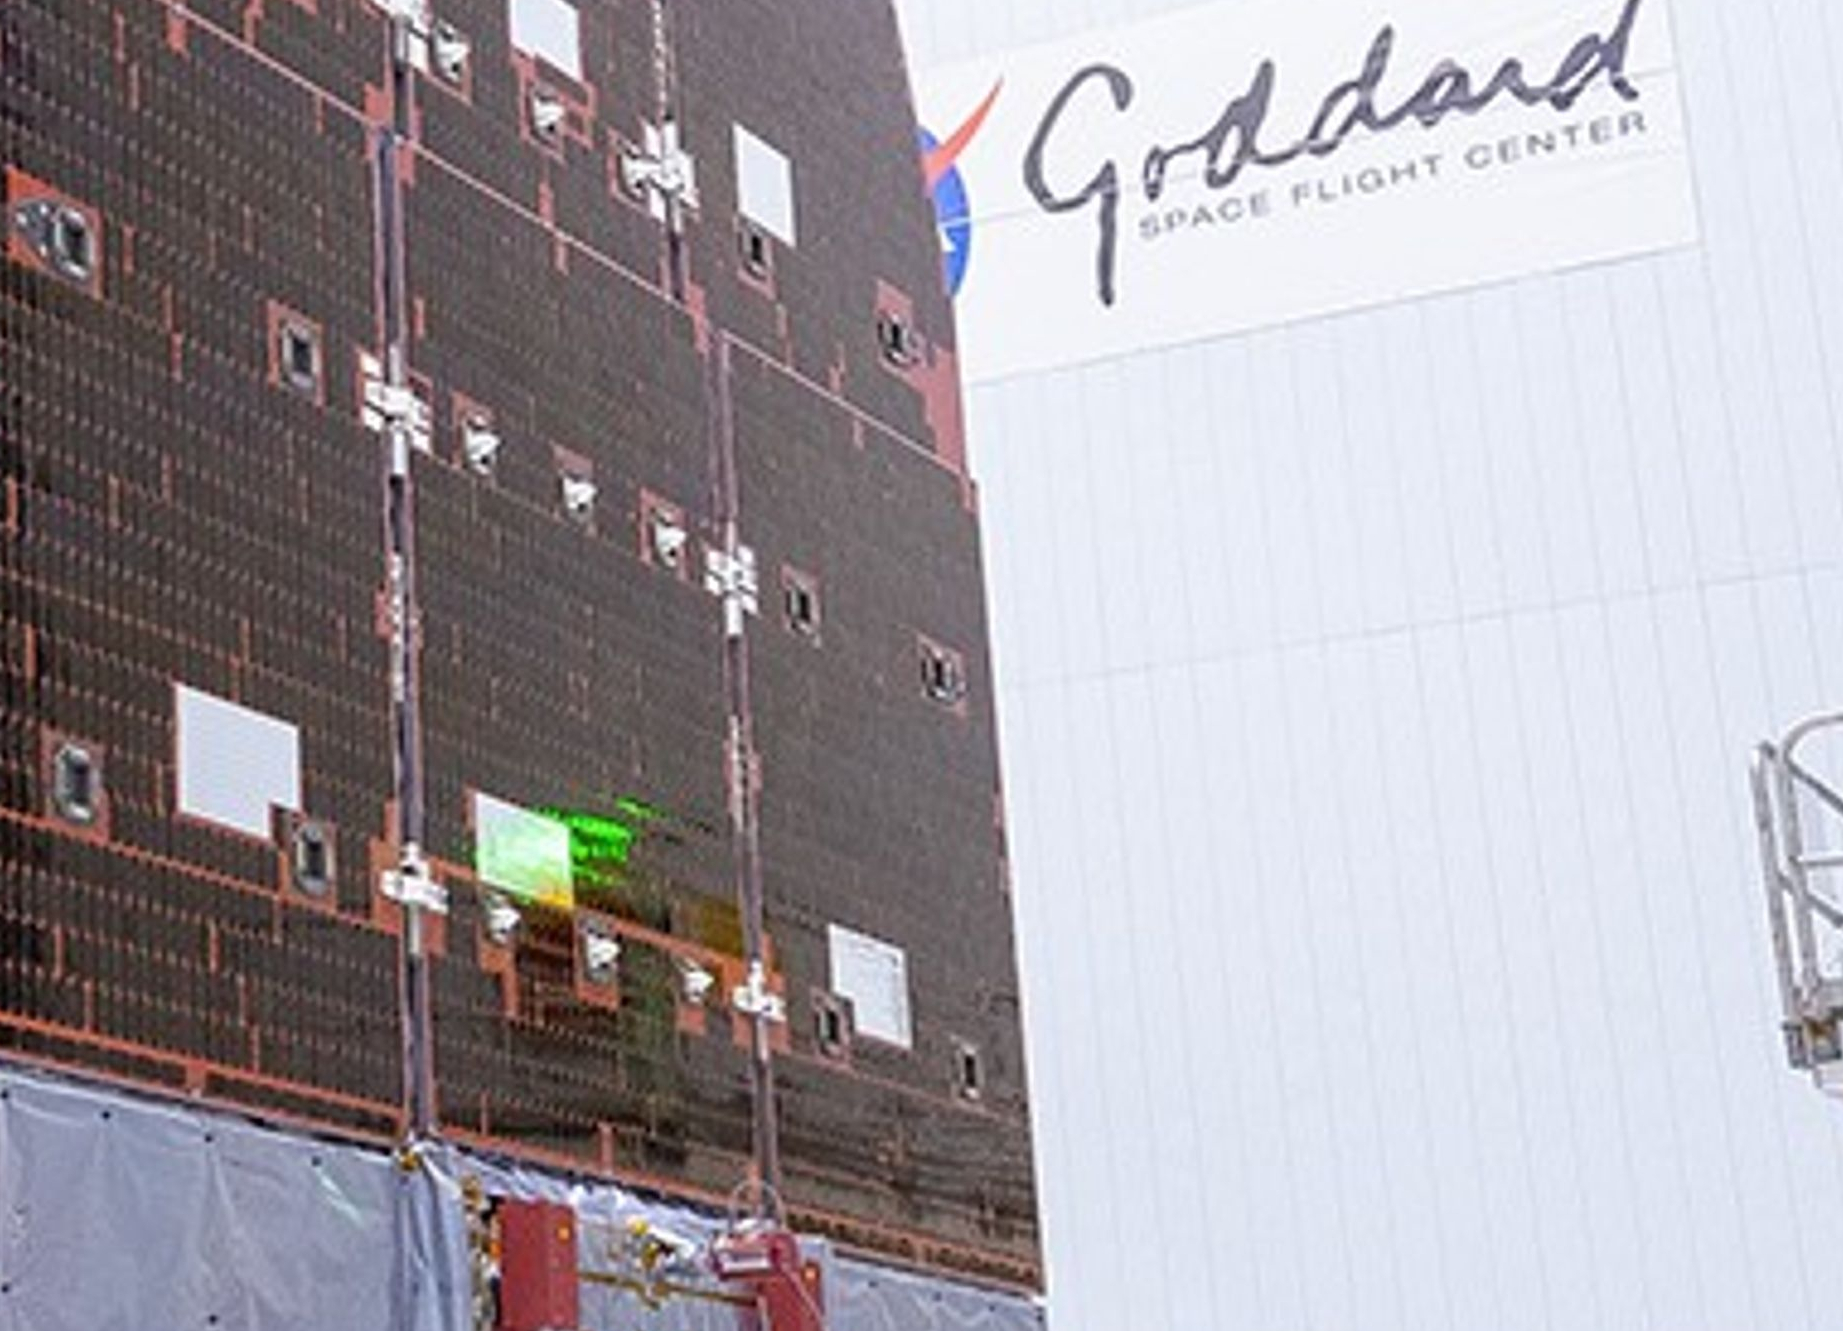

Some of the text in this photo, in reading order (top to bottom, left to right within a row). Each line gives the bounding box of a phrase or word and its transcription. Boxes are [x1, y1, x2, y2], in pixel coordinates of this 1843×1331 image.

[1138, 111, 1648, 239] SPACE FLIGHT CENTER
